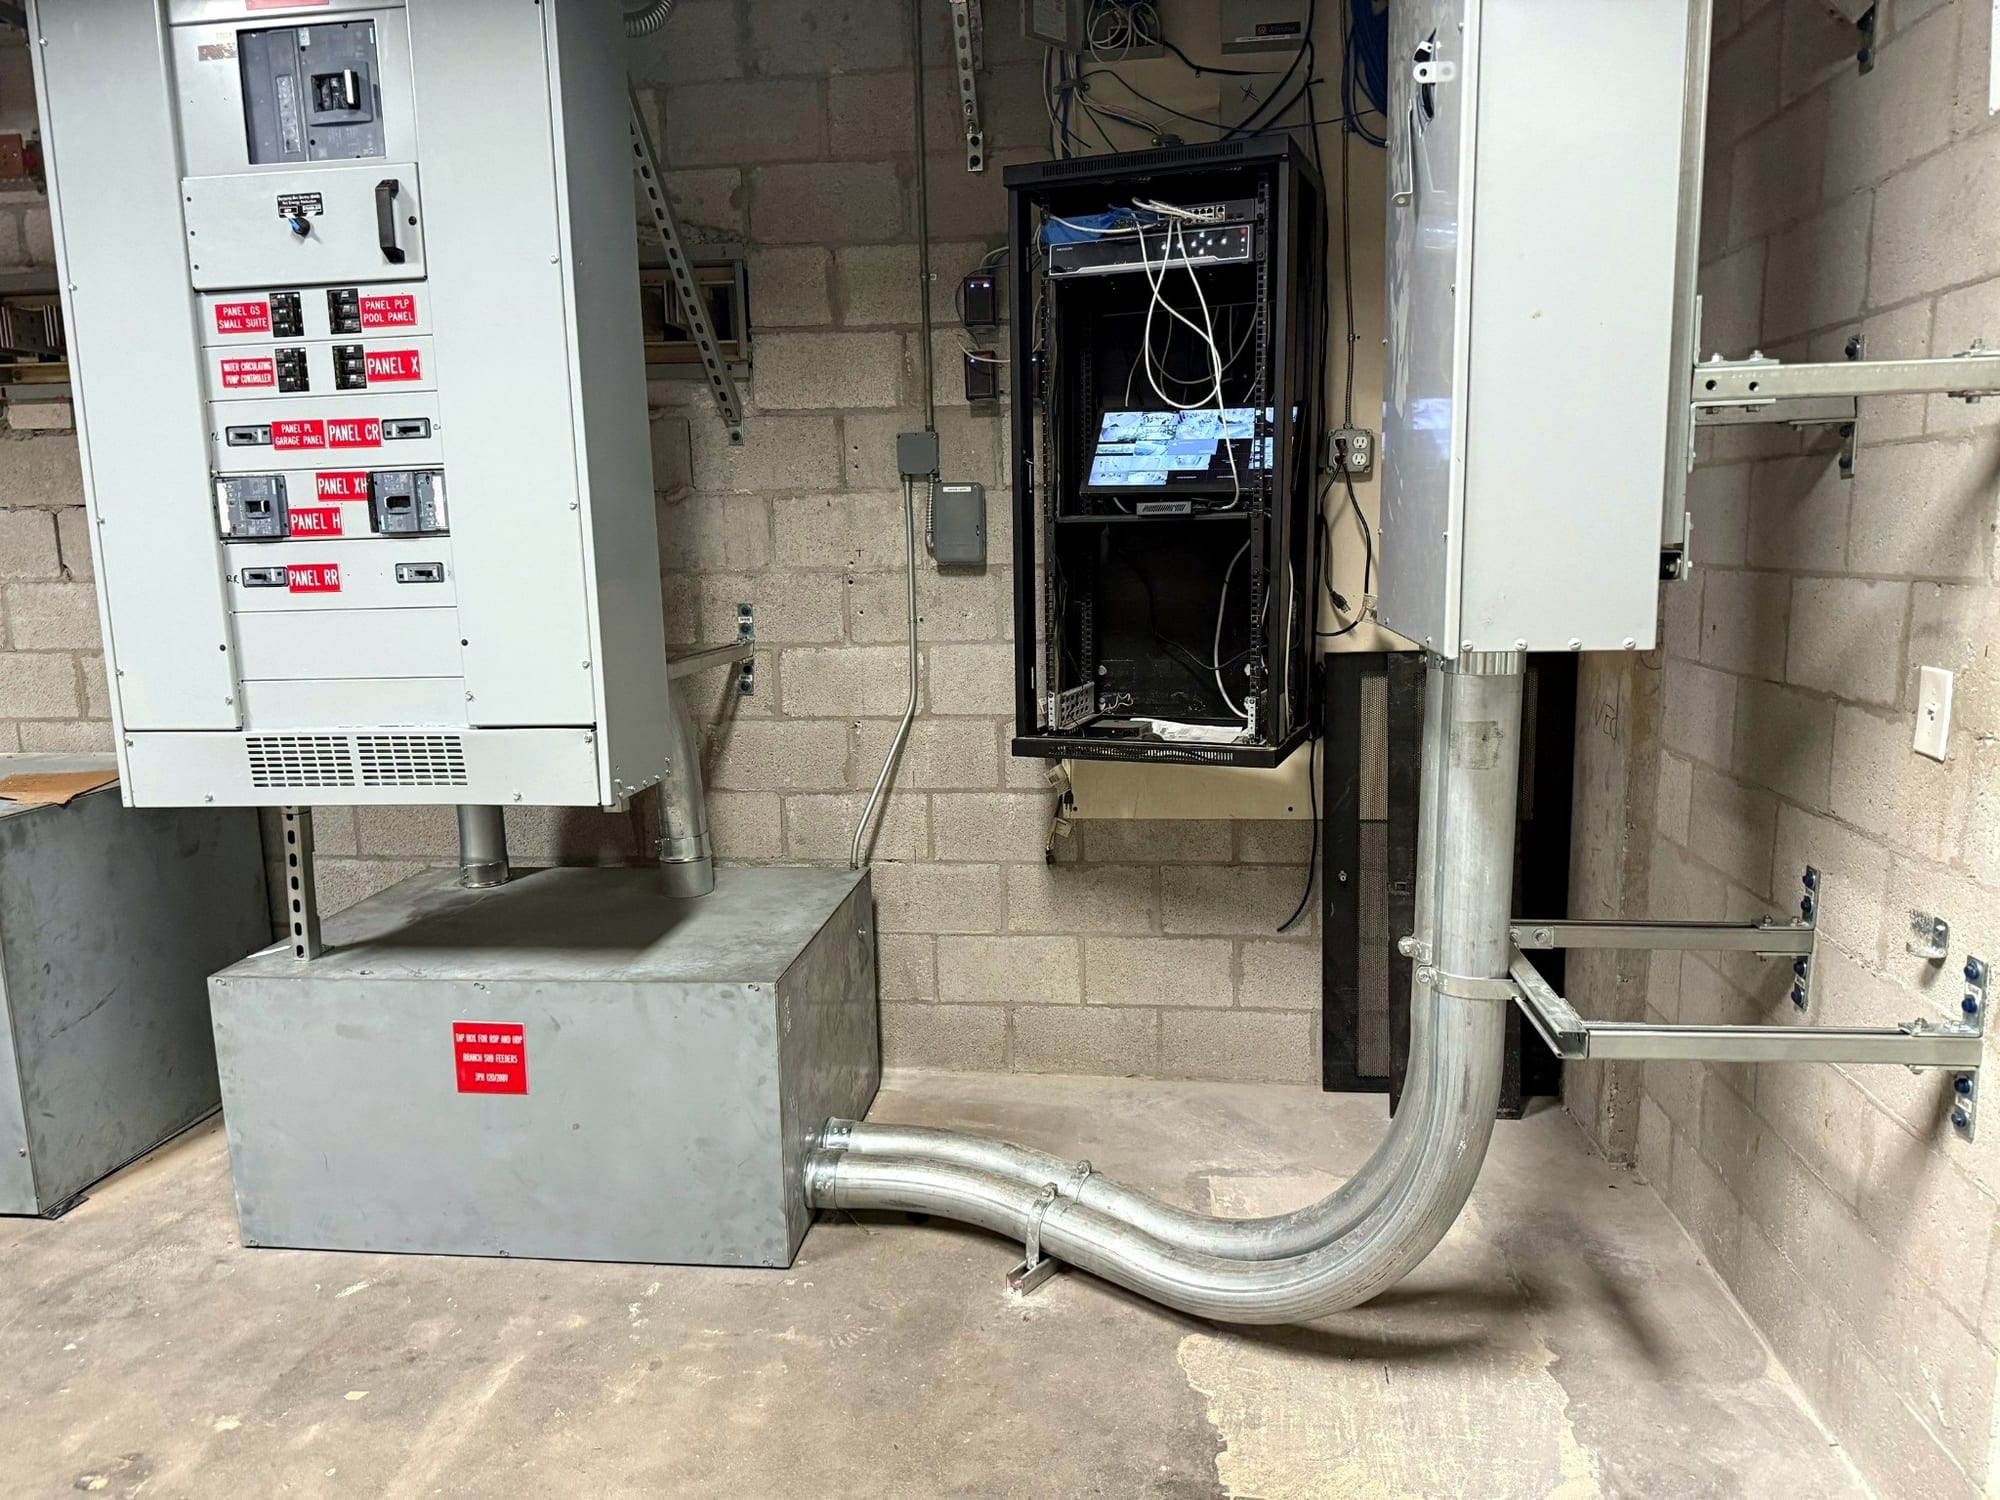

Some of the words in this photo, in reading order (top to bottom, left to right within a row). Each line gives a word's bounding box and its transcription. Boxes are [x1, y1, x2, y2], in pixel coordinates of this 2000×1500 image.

[365, 300, 391, 310] PANEL
[394, 298, 410, 309] PLP
[222, 306, 247, 316] PANEL
[250, 305, 261, 315] GS
[218, 318, 243, 329] SMALL
[245, 317, 268, 328] SUITE
[363, 313, 385, 323] POOL
[387, 311, 414, 322] PANEL
[223, 362, 240, 372] WATER
[240, 361, 272, 372] CIRCULATING
[367, 356, 406, 375] PANEL
[410, 356, 420, 373] X
[226, 374, 240, 385] PUMP
[240, 373, 272, 384] CONTROLLER
[281, 423, 302, 433] PANEL
[304, 423, 313, 433] PL
[328, 423, 362, 442] PANEL
[364, 423, 380, 441] CR
[275, 436, 300, 446] GARAGE
[303, 435, 324, 445] PANEL
[318, 477, 350, 495] PANEL
[354, 476, 368, 493] XH
[290, 513, 328, 530] PANEL
[332, 512, 341, 529] H
[289, 570, 321, 587] PANEL
[323, 568, 339, 586] RR
[455, 1033, 465, 1043] TAP
[466, 1034, 476, 1043] BOX
[478, 1034, 488, 1043] FOR
[501, 1035, 511, 1044] AND
[463, 1053, 482, 1062] BRANCH
[484, 1053, 494, 1063] SUB
[495, 1054, 518, 1064] FEEDERS
